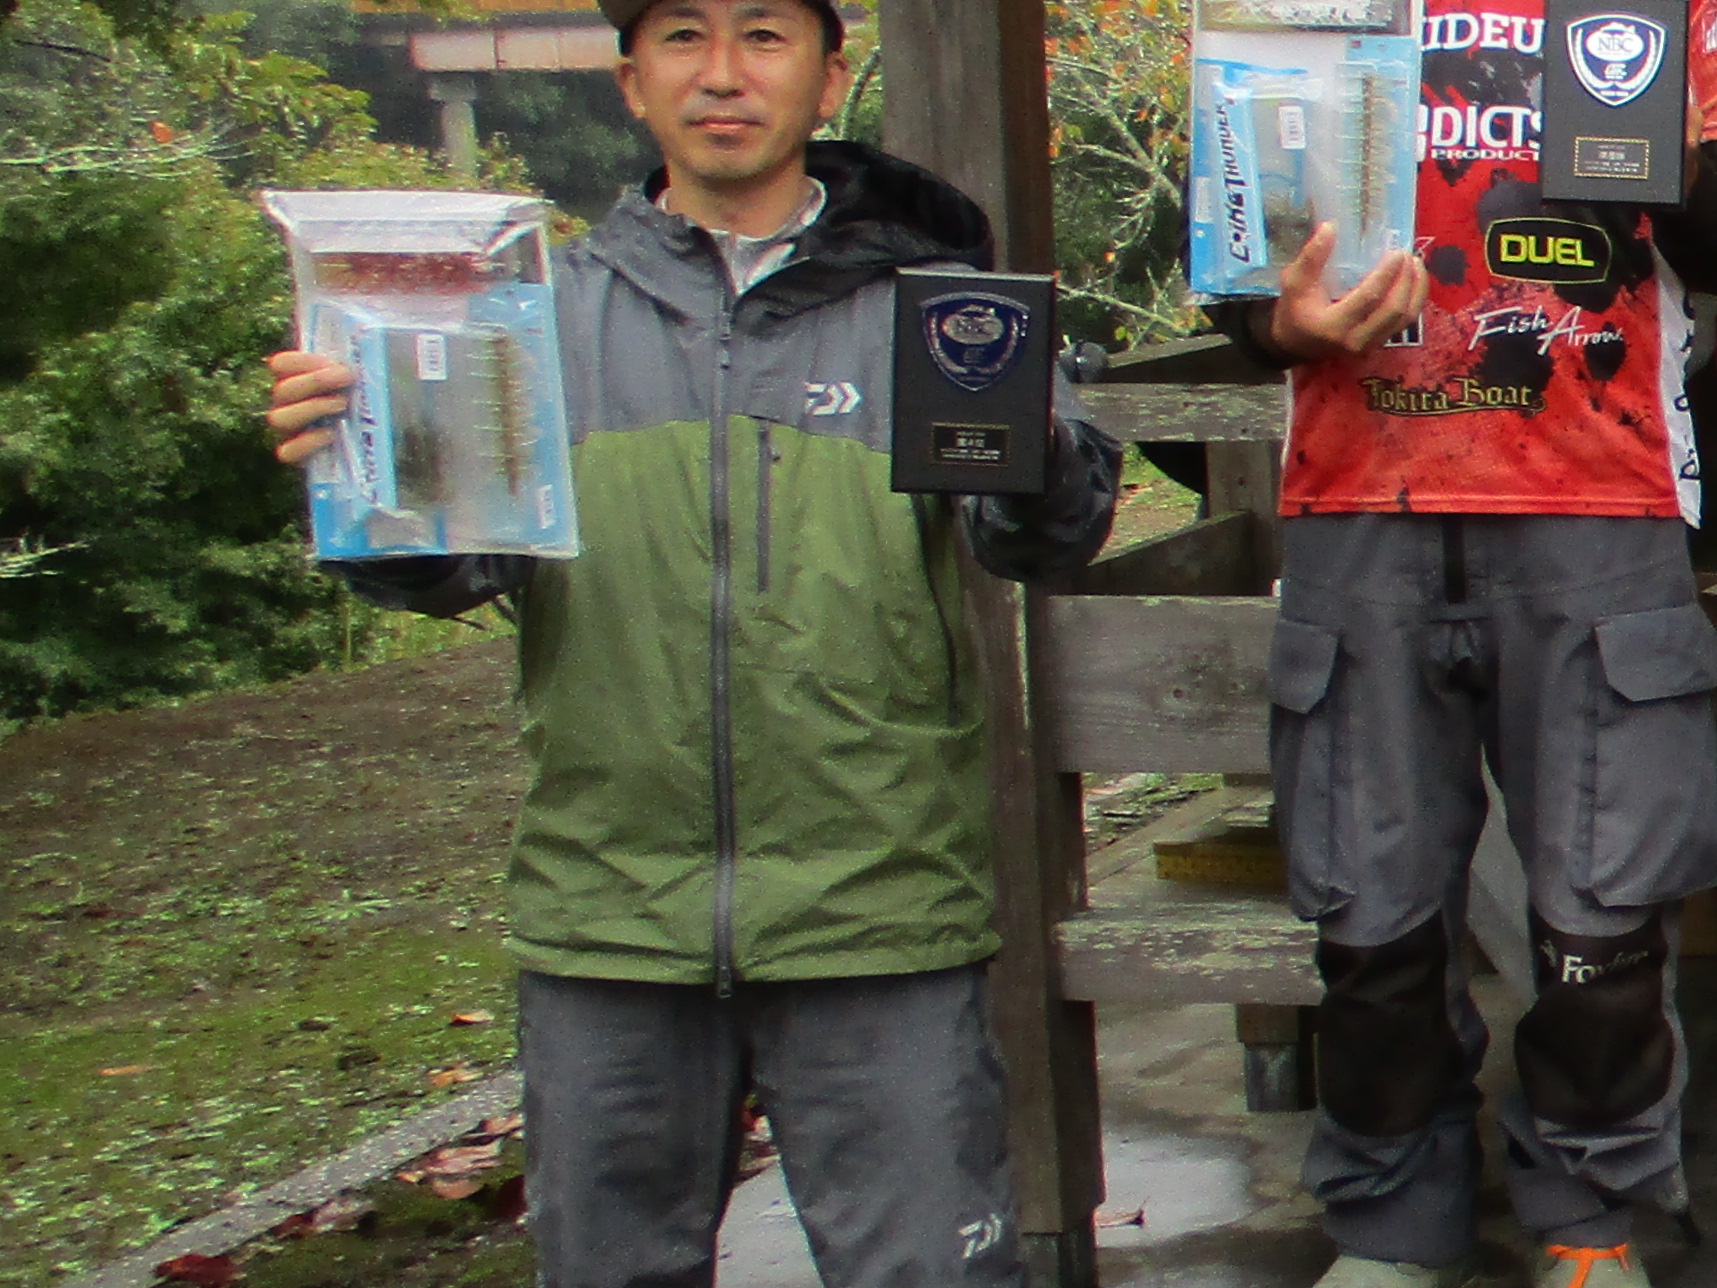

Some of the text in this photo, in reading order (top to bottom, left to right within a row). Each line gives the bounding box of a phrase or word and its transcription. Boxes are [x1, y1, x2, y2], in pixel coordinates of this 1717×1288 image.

[1596, 37, 1634, 53] NBC
[1500, 233, 1595, 266] DUEL
[1467, 305, 1549, 352] Fish
